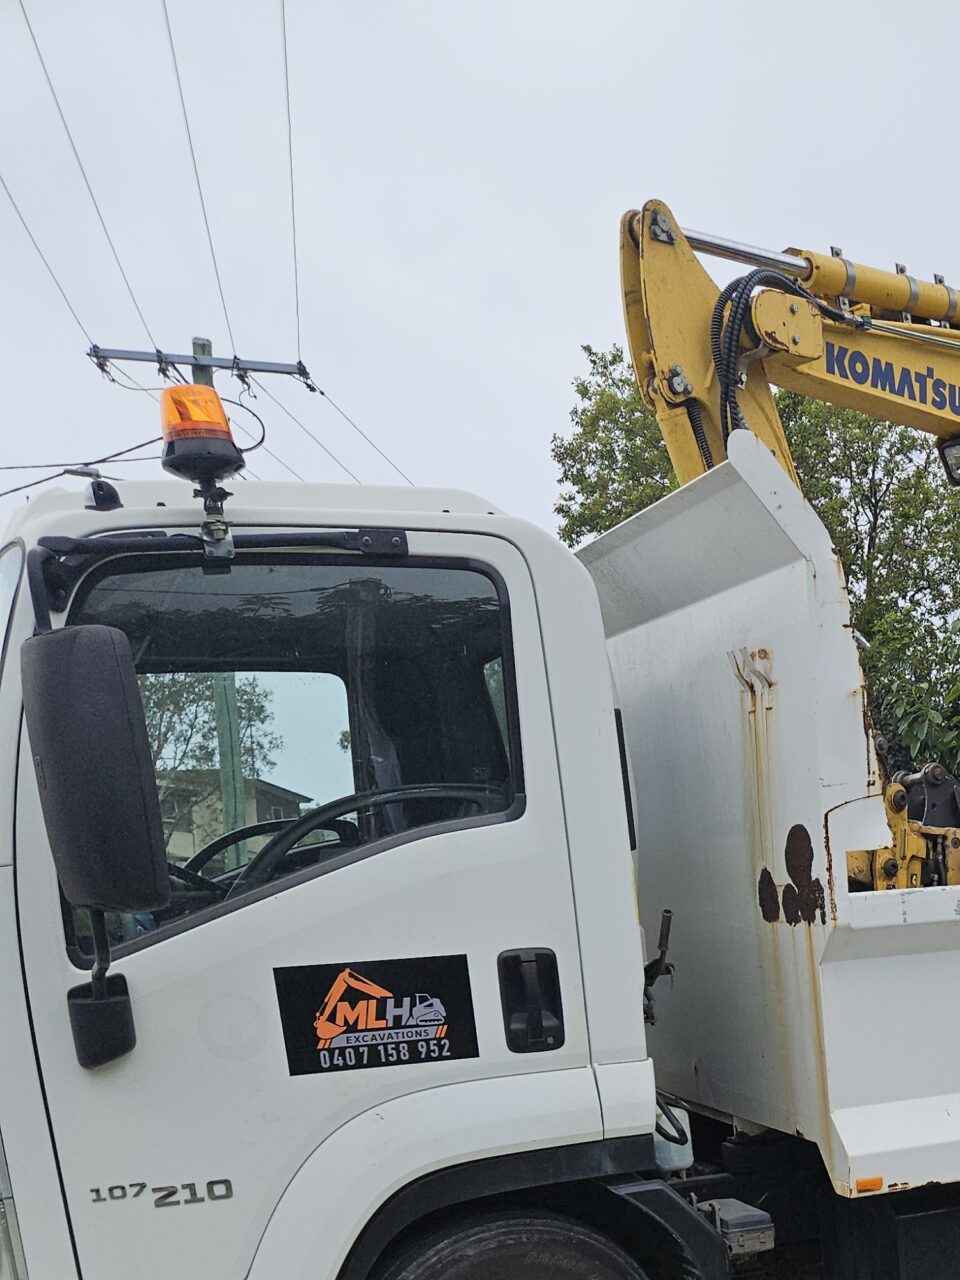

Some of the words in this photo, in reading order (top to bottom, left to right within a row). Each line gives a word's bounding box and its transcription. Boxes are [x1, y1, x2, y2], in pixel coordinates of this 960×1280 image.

[335, 997, 411, 1030] MLH
[346, 1029, 430, 1045] EXCAVATIONS
[319, 1046, 369, 1069] 0407
[378, 1043, 410, 1063] 158
[418, 1039, 451, 1058] 952
[89, 1182, 147, 1203] 107
[151, 1179, 234, 1208] 210
